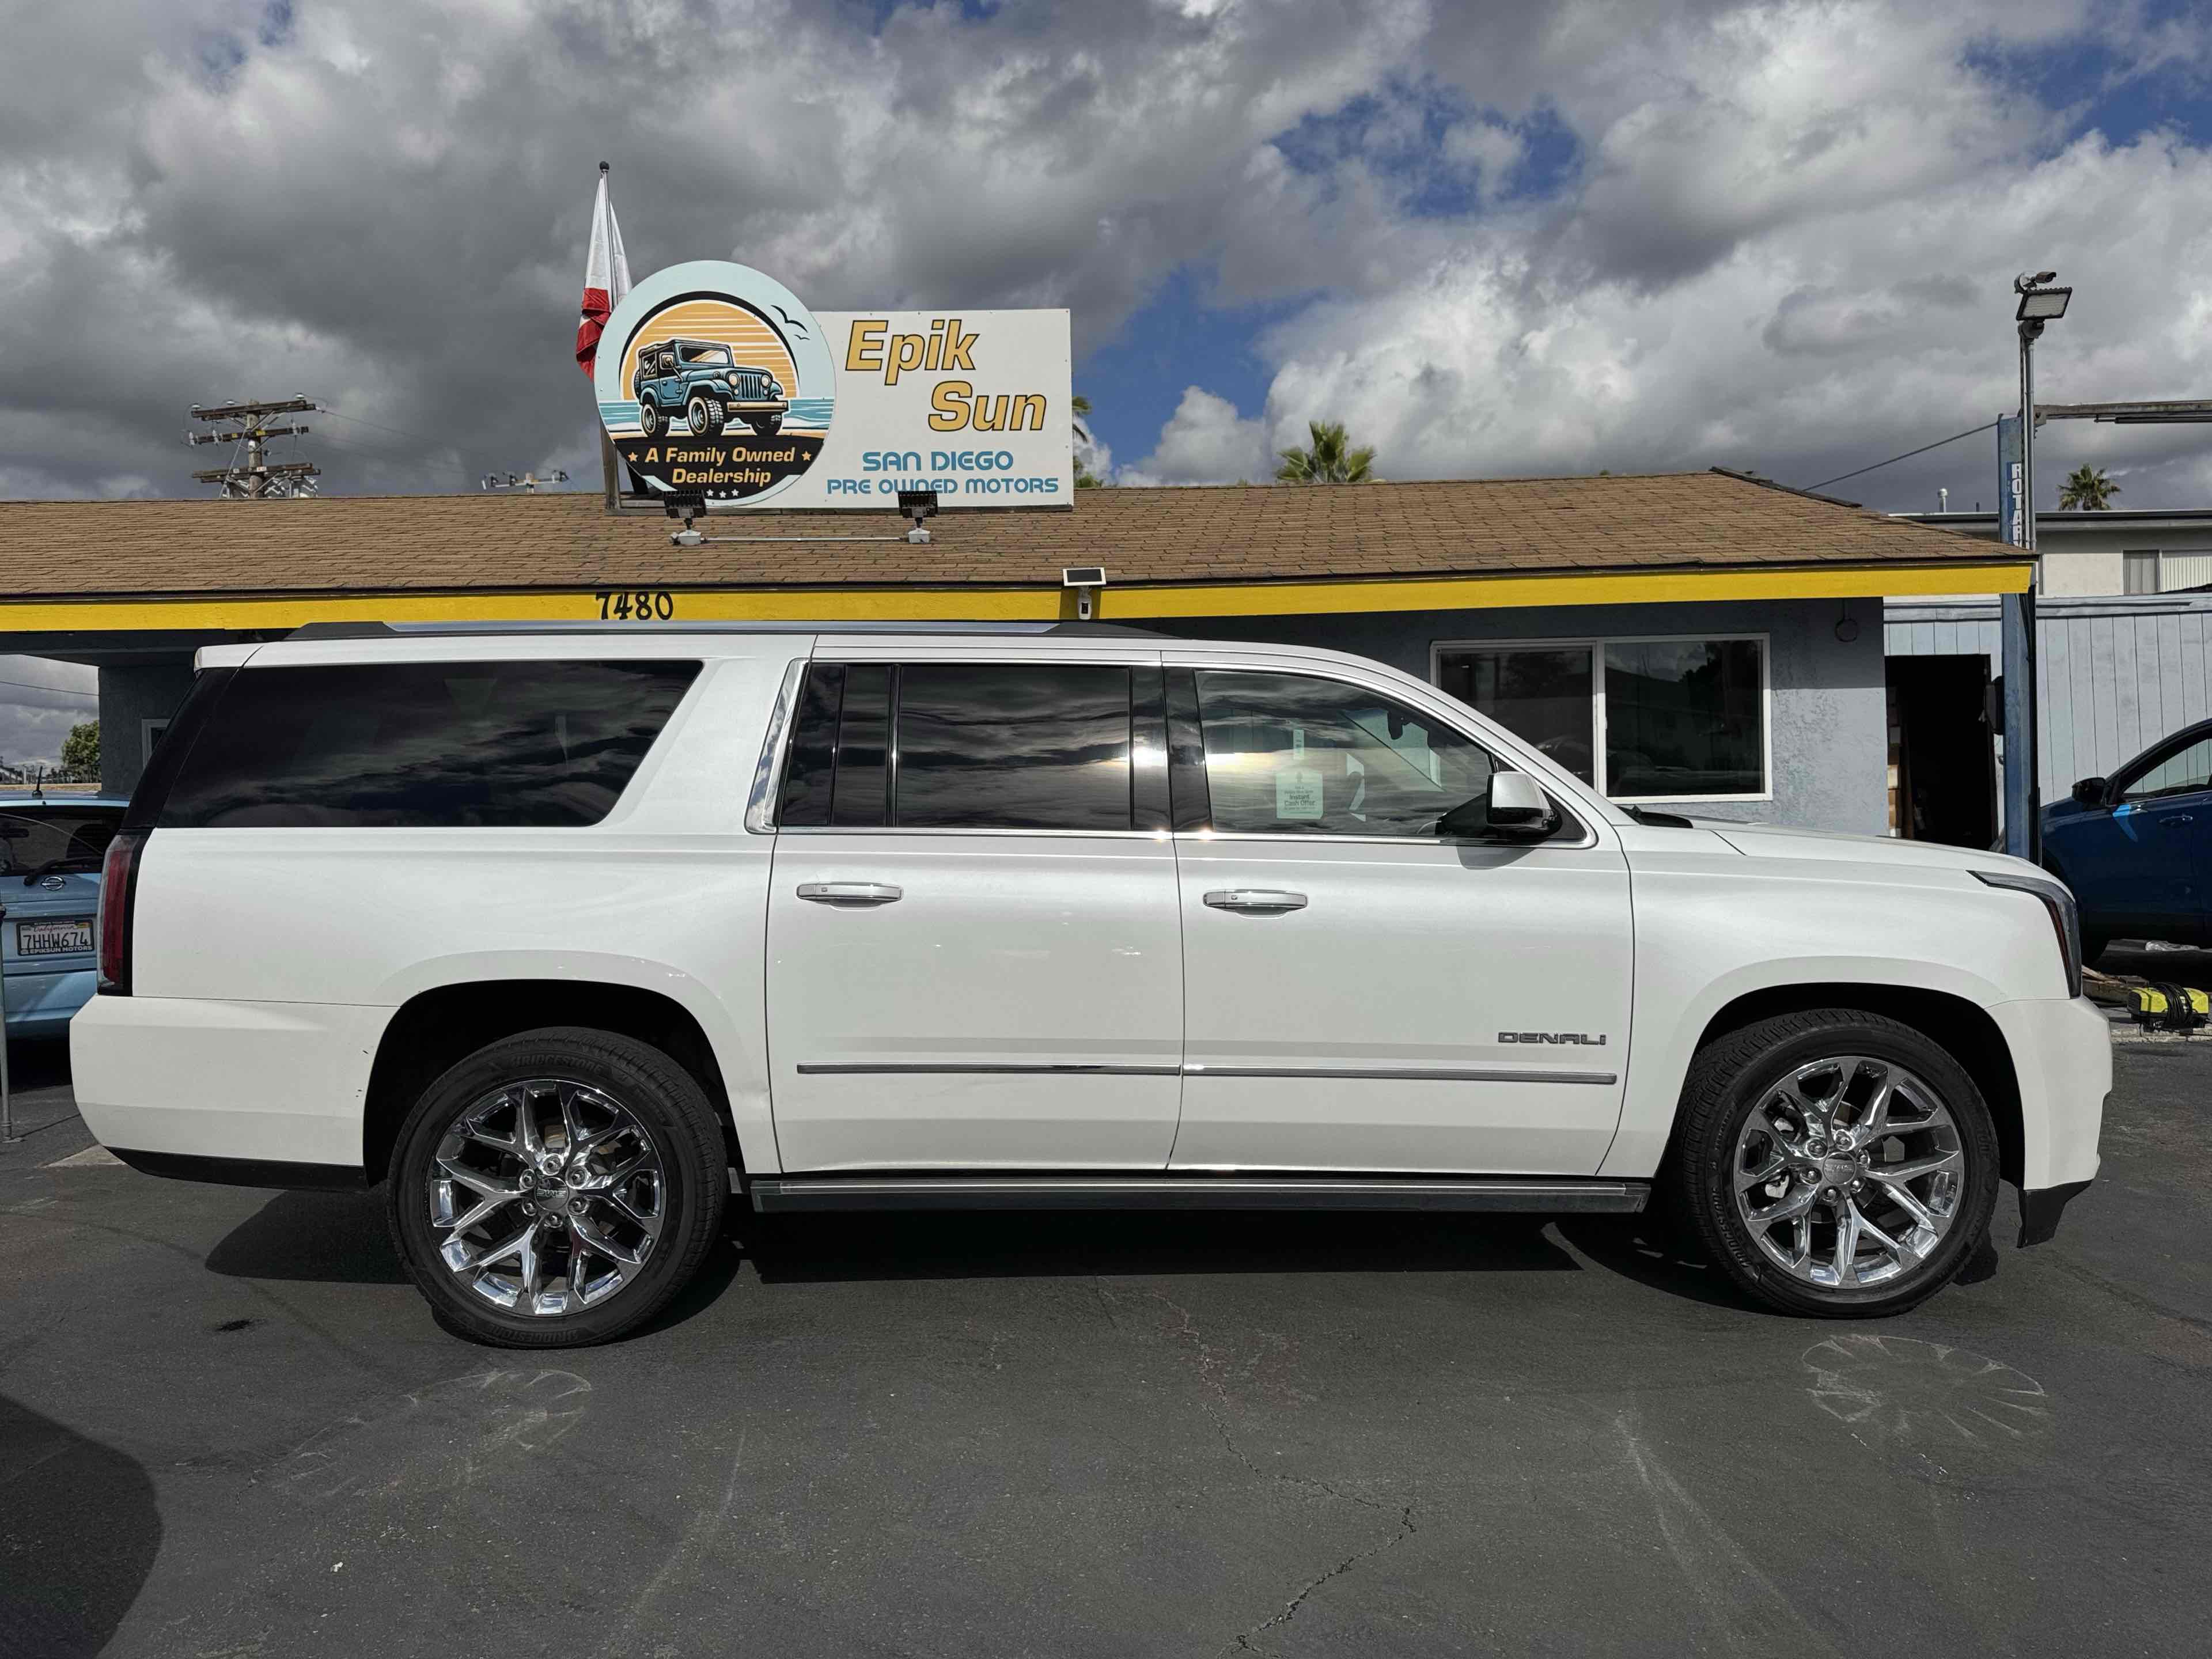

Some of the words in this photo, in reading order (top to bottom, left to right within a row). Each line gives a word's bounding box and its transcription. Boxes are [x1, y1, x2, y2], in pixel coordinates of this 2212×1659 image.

[845, 319, 980, 385] Epik
[928, 380, 1047, 431] Sun
[645, 448, 658, 463] A
[665, 447, 726, 466] Family
[732, 447, 795, 462] Owned
[862, 451, 922, 471] SAN
[931, 451, 1014, 471] DIEGO
[672, 468, 771, 487] Dealership
[827, 479, 872, 494] PRE
[878, 479, 958, 494] OWNED
[965, 478, 1059, 494] MOTORS
[596, 592, 673, 620] 7480
[23, 932, 88, 949] 7HHW674
[62, 945, 92, 953] MOTORS
[1498, 1032, 1606, 1046] DENALI
